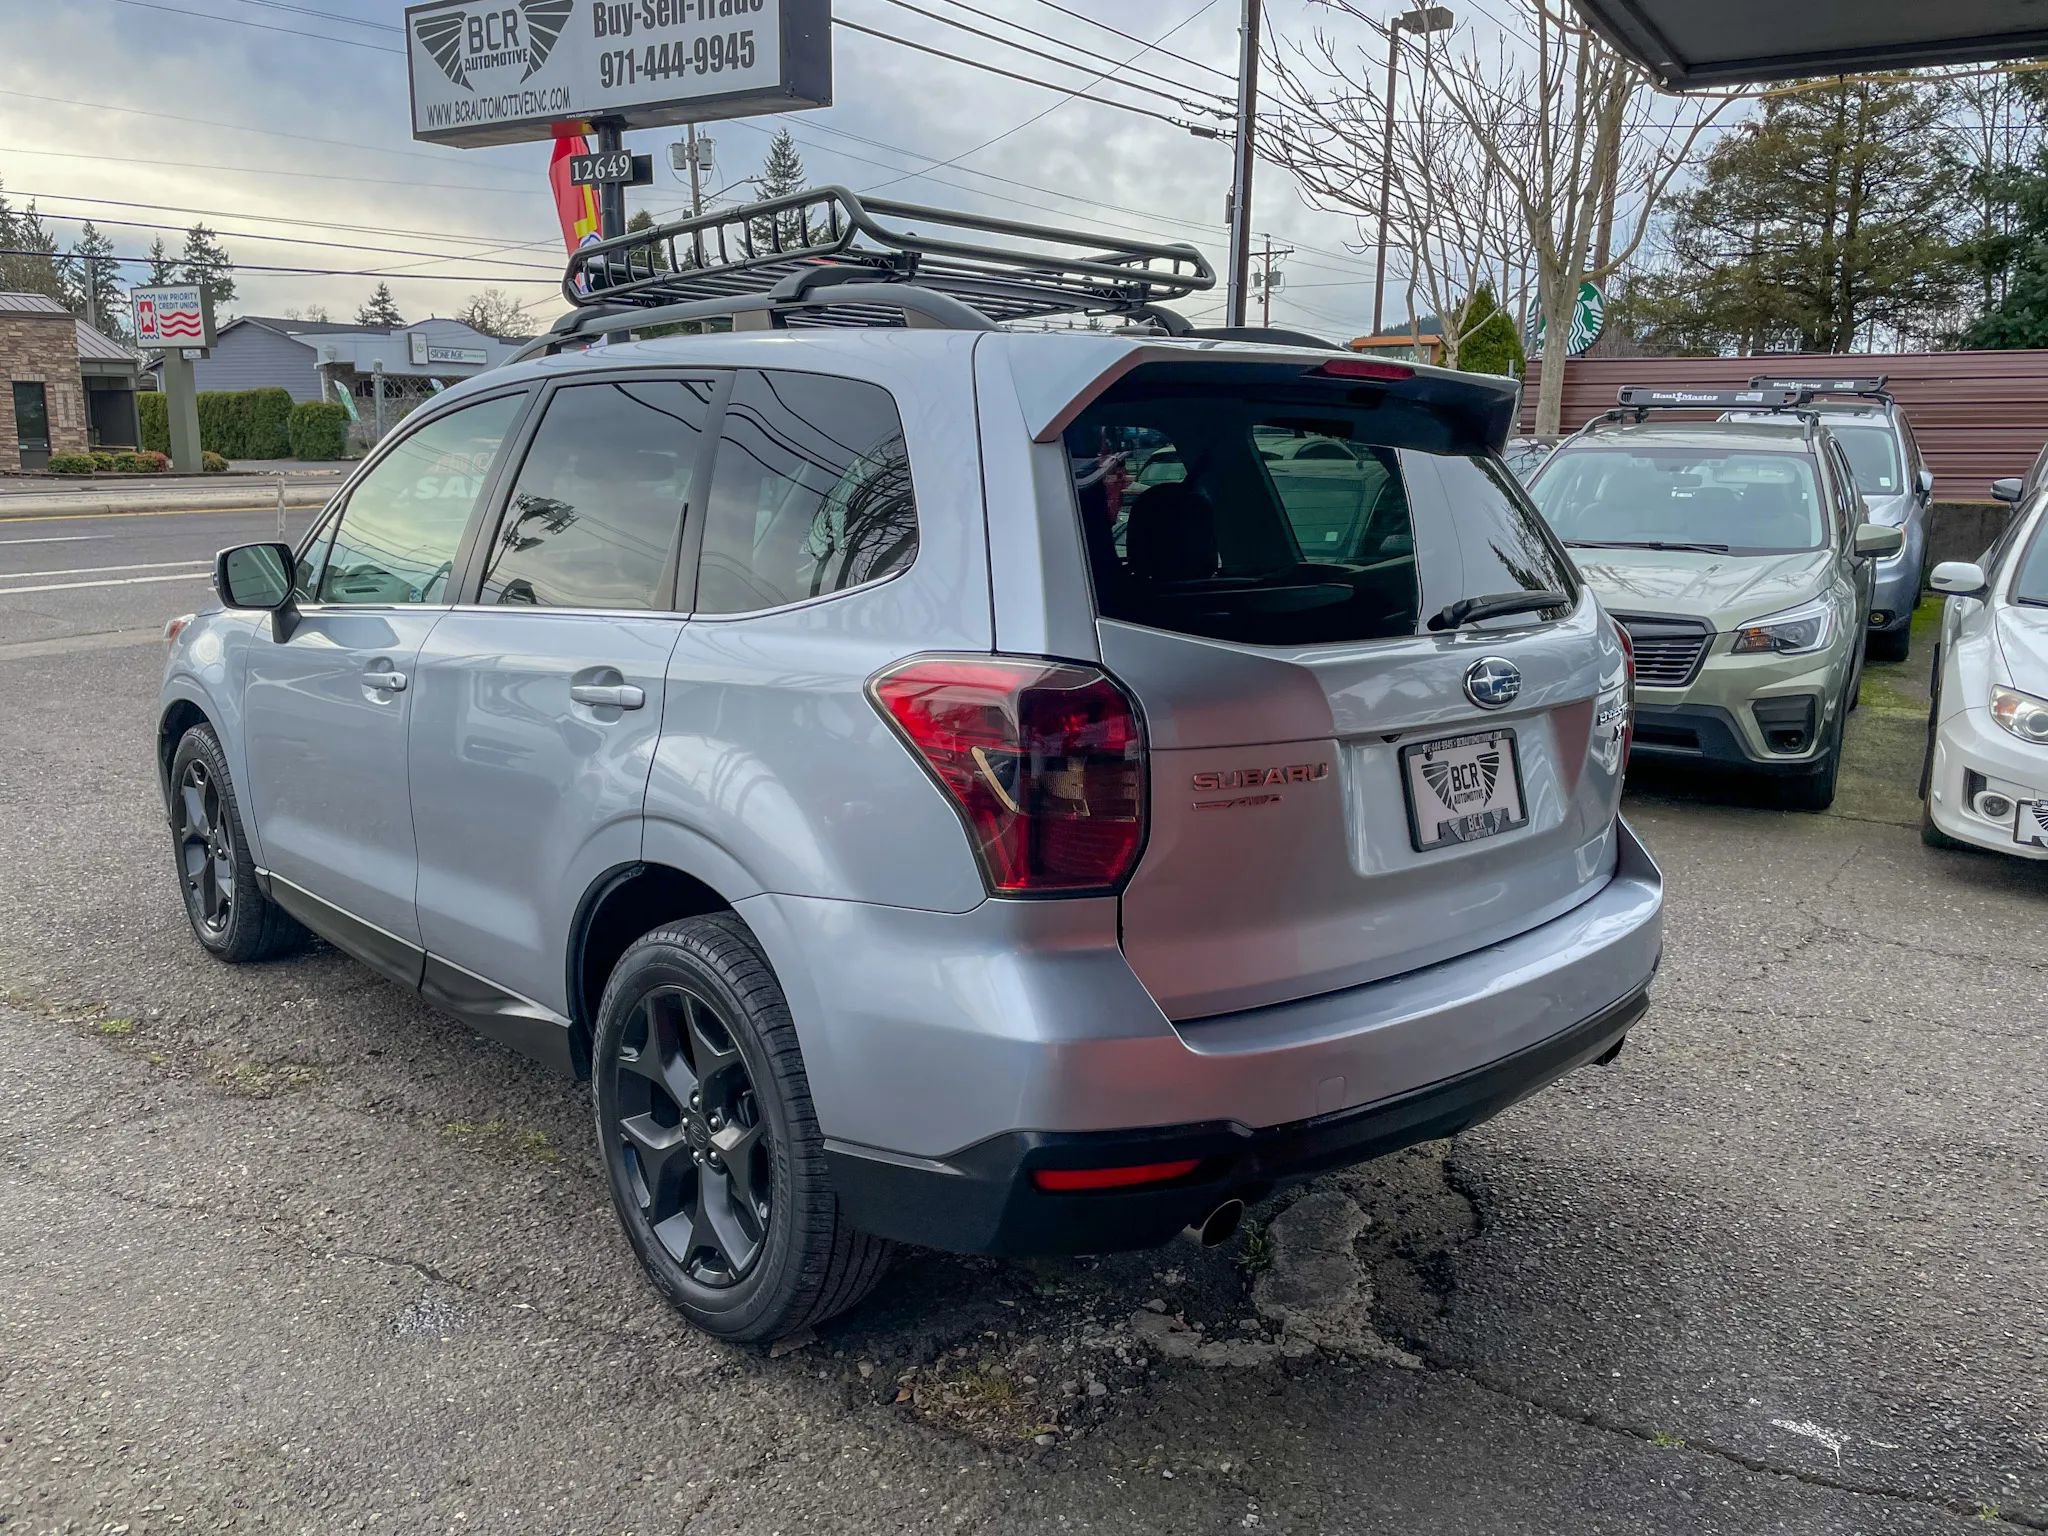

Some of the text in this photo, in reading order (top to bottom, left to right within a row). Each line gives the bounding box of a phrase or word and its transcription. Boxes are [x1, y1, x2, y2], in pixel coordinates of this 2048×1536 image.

[467, 9, 520, 54] BCR
[464, 48, 529, 72] AUTOMOTIVE
[600, 30, 755, 89] 971-444-9945
[427, 86, 571, 127] WWW.BCRAUTOMOTIVEINC.COM
[572, 154, 630, 181] 12649
[157, 292, 198, 301] NW PRIORITY
[158, 301, 199, 310] CREDIT UNION
[1192, 761, 1329, 792] SUBARU
[1450, 763, 1481, 792] BCR
[1453, 788, 1485, 805] AUTOMOTIVE
[1467, 813, 1486, 832] BCR
